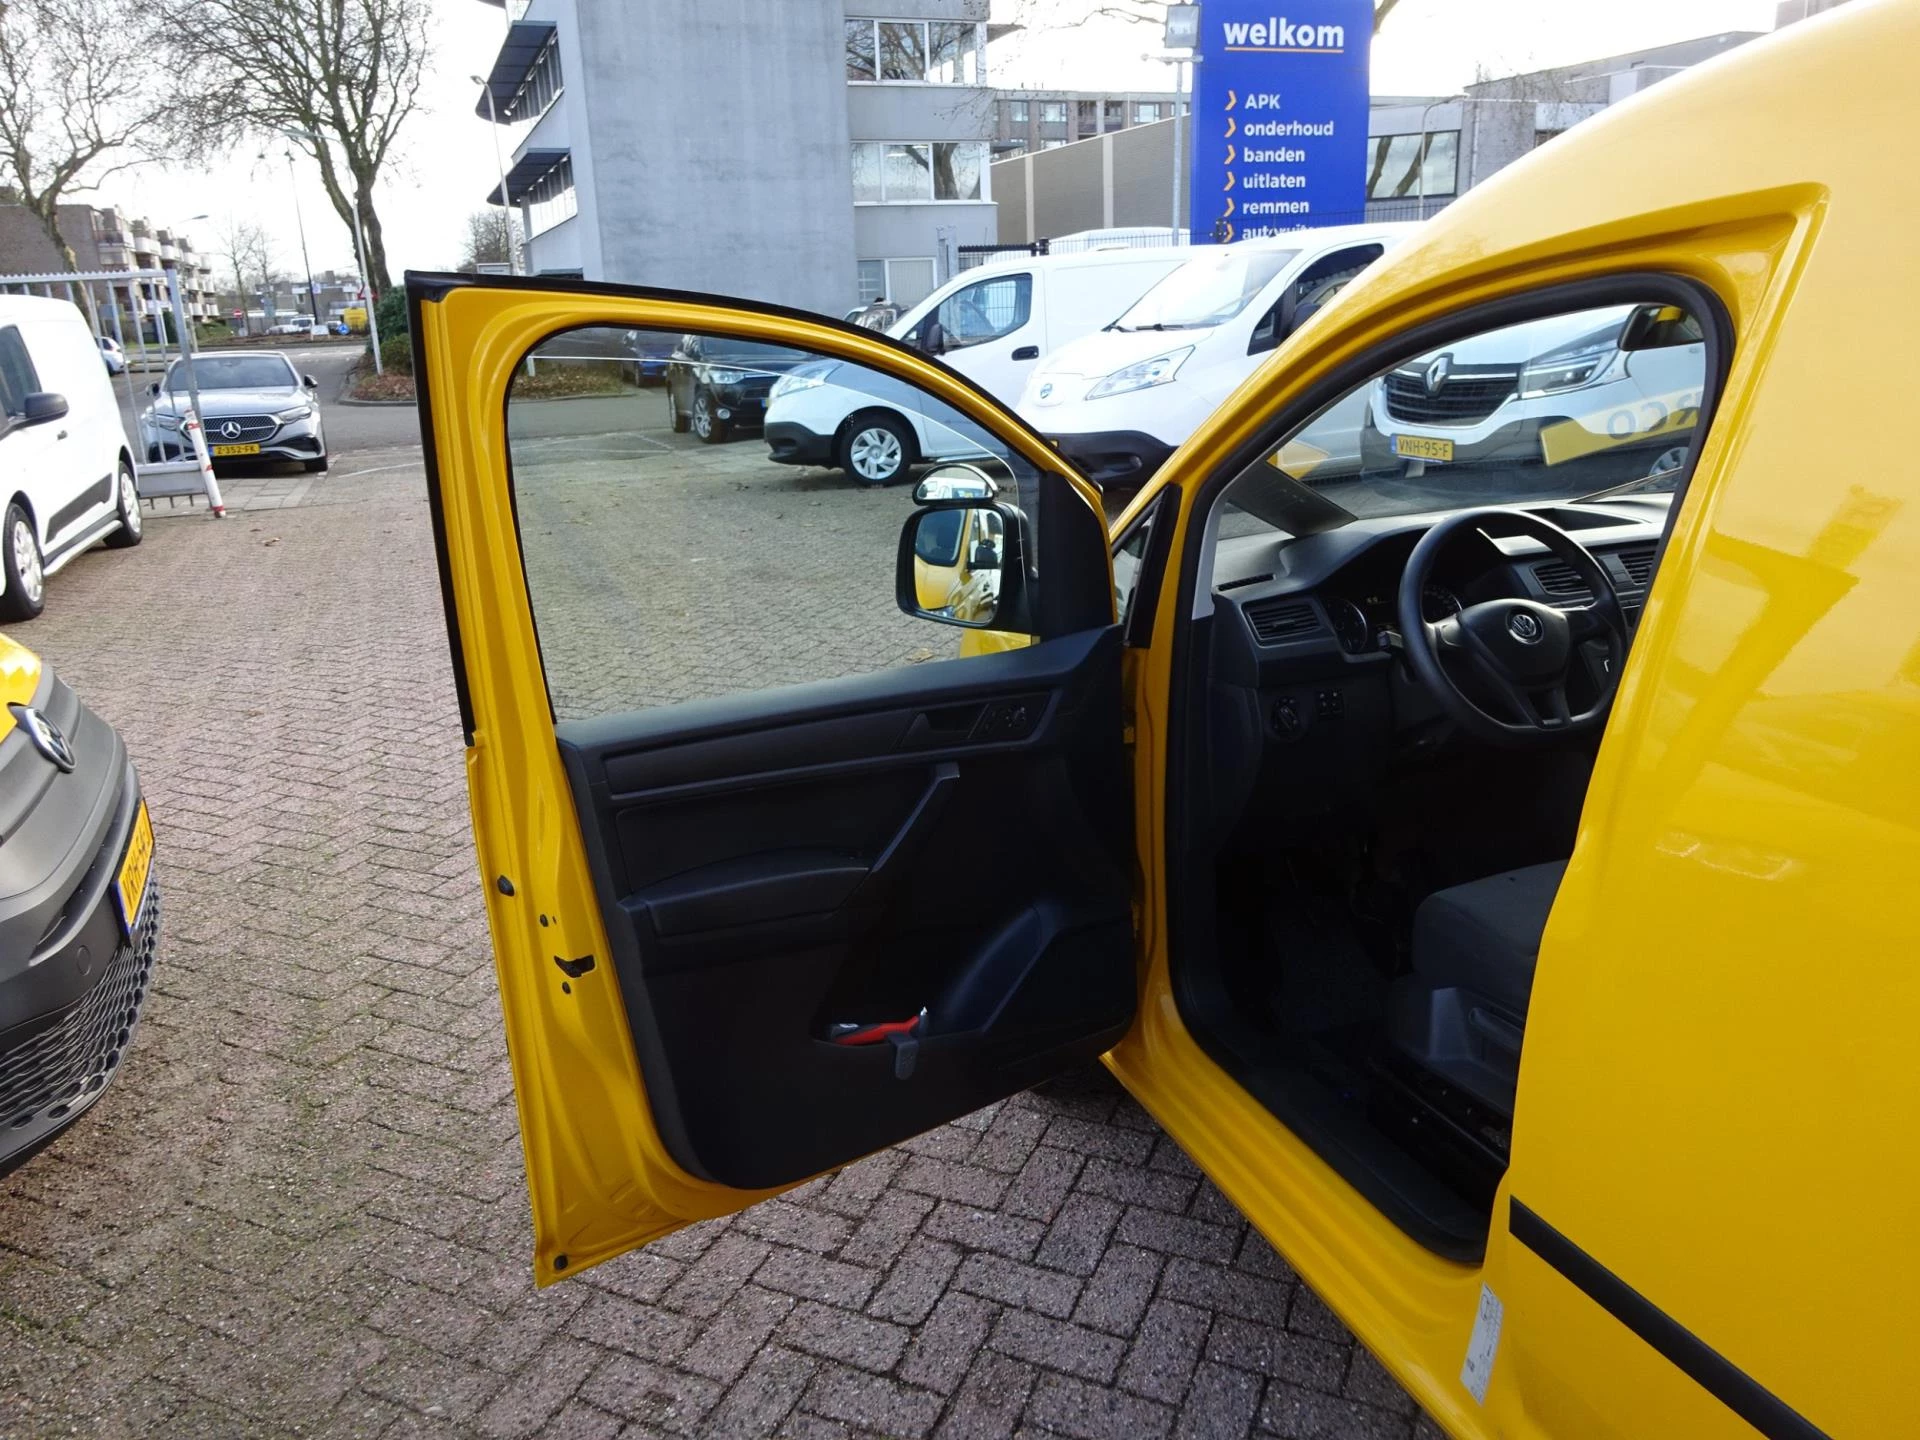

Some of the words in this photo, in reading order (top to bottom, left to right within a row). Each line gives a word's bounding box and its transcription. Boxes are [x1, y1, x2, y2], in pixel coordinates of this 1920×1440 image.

[1223, 17, 1344, 47] welkom
[1244, 93, 1281, 109] APK
[1244, 120, 1334, 136] onderhoud
[1243, 147, 1306, 163] banden
[1243, 173, 1306, 188] uitlaten
[1242, 201, 1310, 214] remmen
[1398, 438, 1449, 457] VNH-95-F
